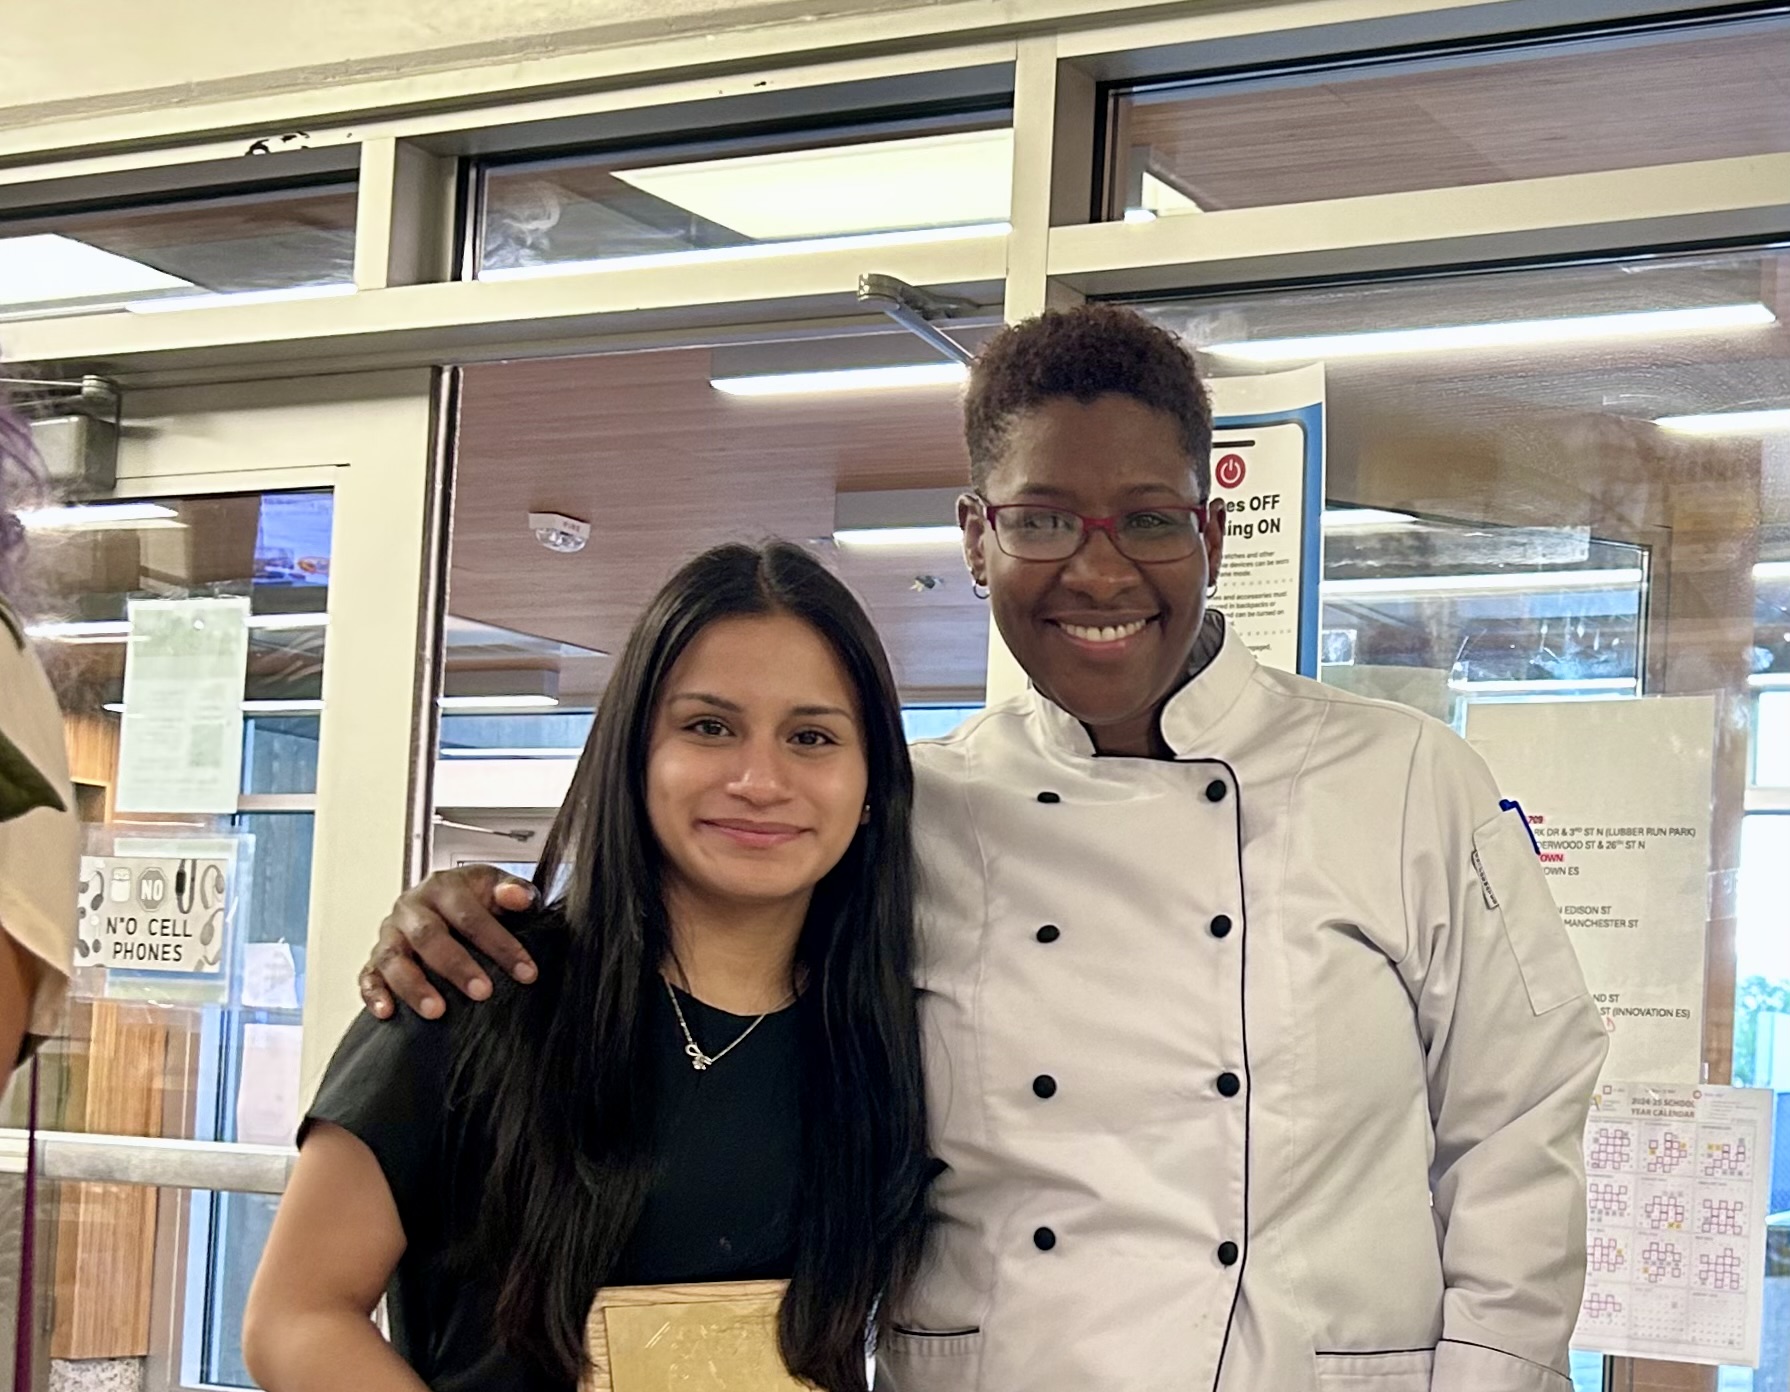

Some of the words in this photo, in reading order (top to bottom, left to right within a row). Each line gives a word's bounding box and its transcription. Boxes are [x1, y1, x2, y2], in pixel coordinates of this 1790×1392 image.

[1249, 494, 1280, 512] OFF
[1227, 520, 1254, 540] ing
[1257, 518, 1281, 534] ON
[1547, 828, 1560, 837] DR
[1561, 828, 1568, 837] &
[1584, 828, 1595, 837] ST
[1597, 828, 1604, 837] N
[1605, 827, 1645, 838] (LUBBER
[1646, 828, 1667, 837] RUN
[1585, 841, 1597, 850] ST
[1597, 841, 1604, 850] &
[1625, 841, 1637, 850] ST
[1638, 841, 1646, 850] N
[1568, 867, 1580, 876] ES
[141, 879, 164, 901] NO
[1564, 906, 1599, 915] EDISON
[1601, 906, 1612, 915] ST
[148, 918, 193, 938] CELL
[1628, 919, 1639, 928] ST
[113, 942, 183, 962] PHONES
[1608, 993, 1620, 1003] ST
[1600, 1007, 1611, 1016] ST
[1612, 1007, 1673, 1018] (INNOVATION
[1675, 1009, 1691, 1019] ES)
